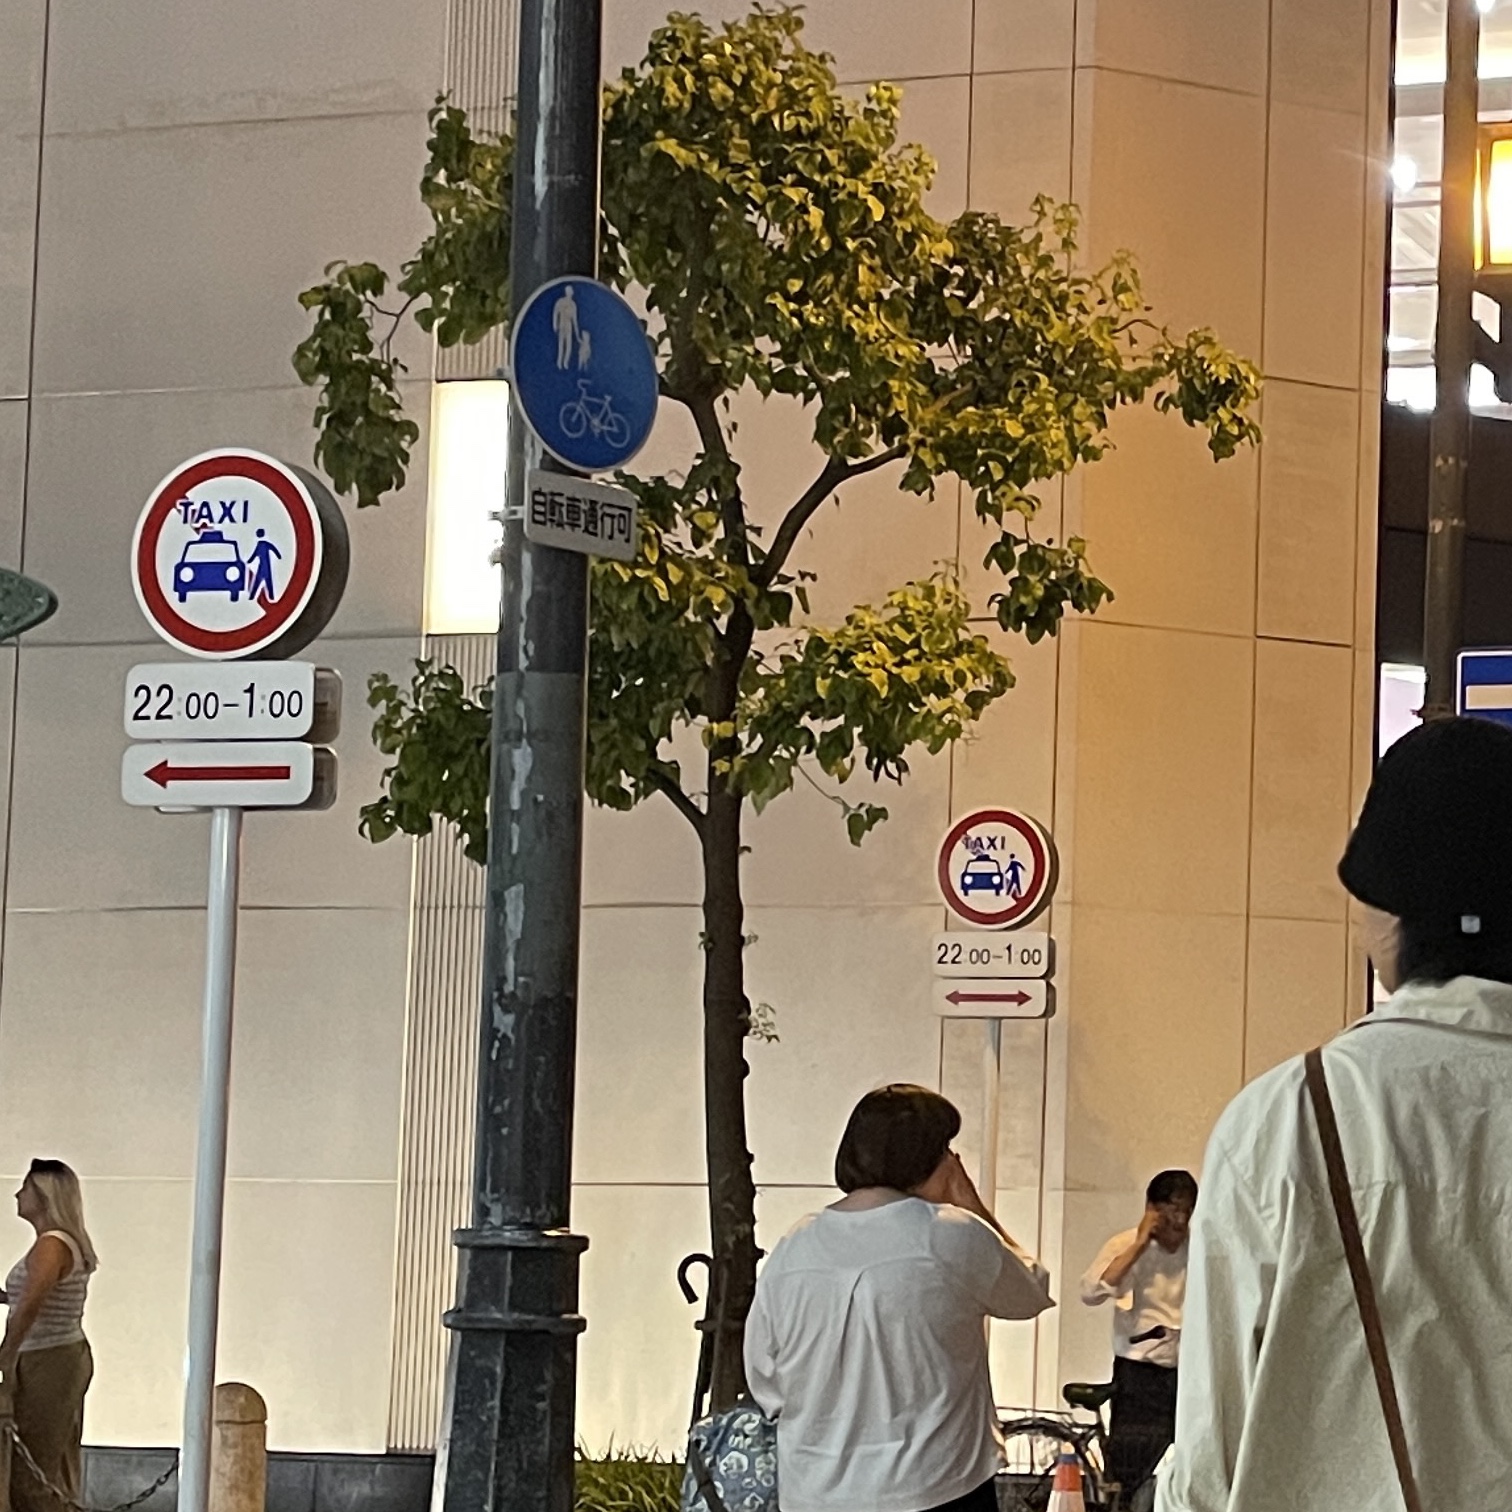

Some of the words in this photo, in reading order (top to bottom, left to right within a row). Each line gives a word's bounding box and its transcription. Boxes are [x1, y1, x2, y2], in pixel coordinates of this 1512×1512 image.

[177, 499, 250, 525] TAXI
[531, 487, 634, 544] 自転車通行可
[962, 835, 1007, 851] TAXI
